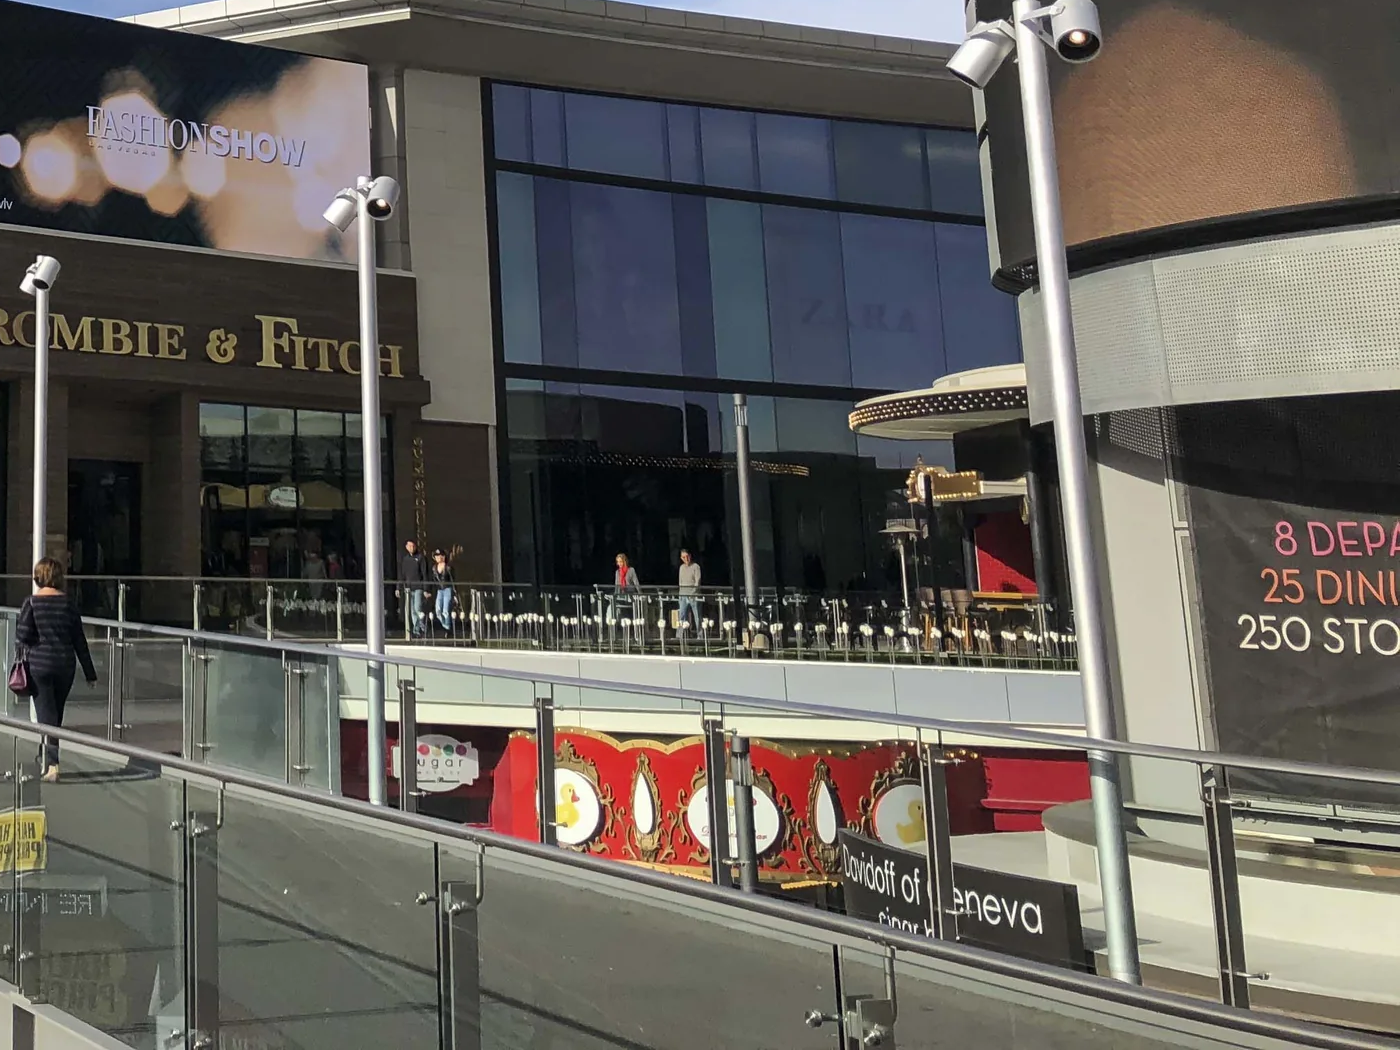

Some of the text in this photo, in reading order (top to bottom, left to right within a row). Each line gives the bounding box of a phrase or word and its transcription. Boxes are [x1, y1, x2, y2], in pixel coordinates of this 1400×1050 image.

[206, 327, 238, 364] &
[1275, 521, 1298, 556] 8
[1260, 568, 1305, 604] 25
[1238, 614, 1400, 656] 250 STO
[417, 758, 463, 770] ugar
[842, 843, 896, 897] Davidoff
[901, 867, 921, 906] of
[927, 879, 1043, 936] eneva
